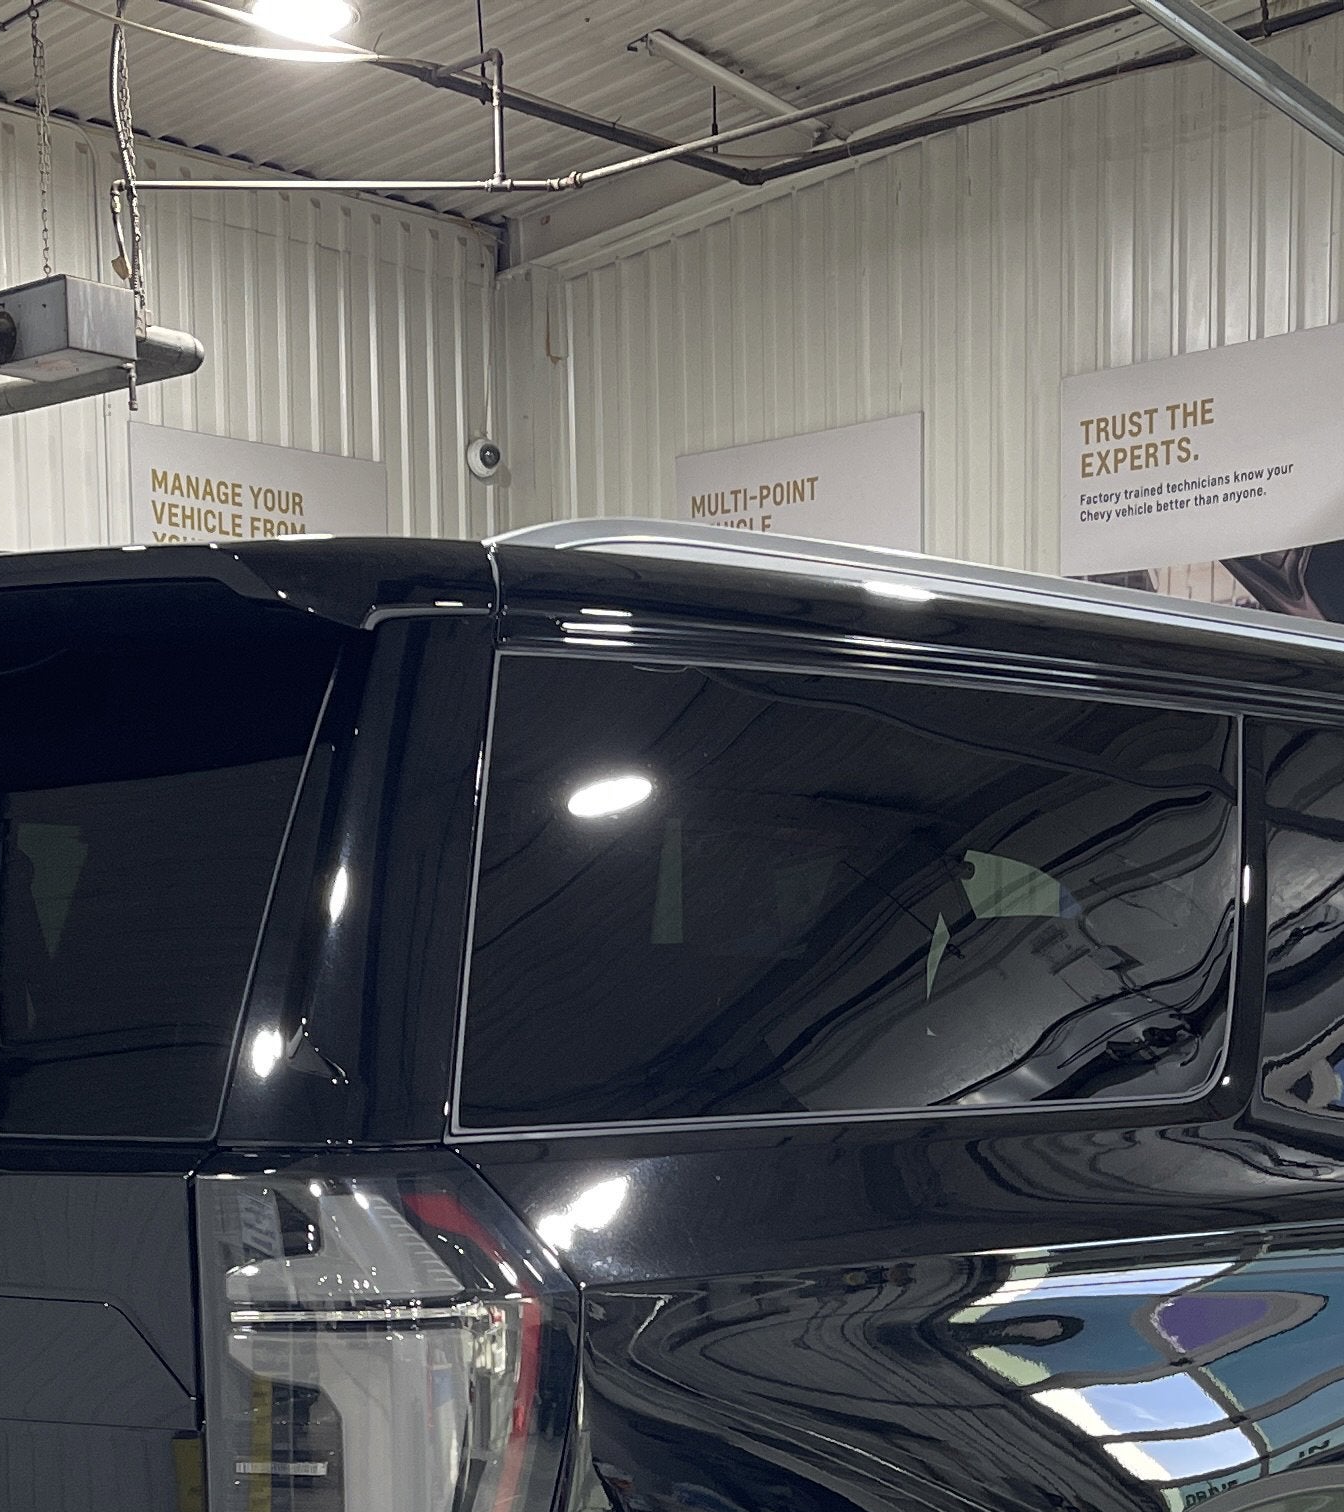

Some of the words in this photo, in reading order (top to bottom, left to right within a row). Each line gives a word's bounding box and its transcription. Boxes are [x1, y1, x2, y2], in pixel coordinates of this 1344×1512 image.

[1080, 407, 1159, 446] TRUST
[1166, 397, 1216, 431] THE
[1081, 436, 1200, 479] EXPERTS.
[151, 468, 243, 507] MANAGE
[248, 485, 304, 517] YOUR
[691, 476, 819, 519] MULTI-POINT
[1080, 490, 1122, 505] Factory
[1124, 482, 1164, 501] trained
[1166, 474, 1231, 494] technicians
[1234, 468, 1265, 484] know
[1266, 463, 1295, 481] your
[1080, 507, 1113, 523] Chevy
[1115, 502, 1153, 518] vehicle
[1156, 497, 1192, 512] better
[1194, 493, 1220, 508] than
[1222, 486, 1268, 504] anyone.
[152, 500, 244, 538] VEHICLE
